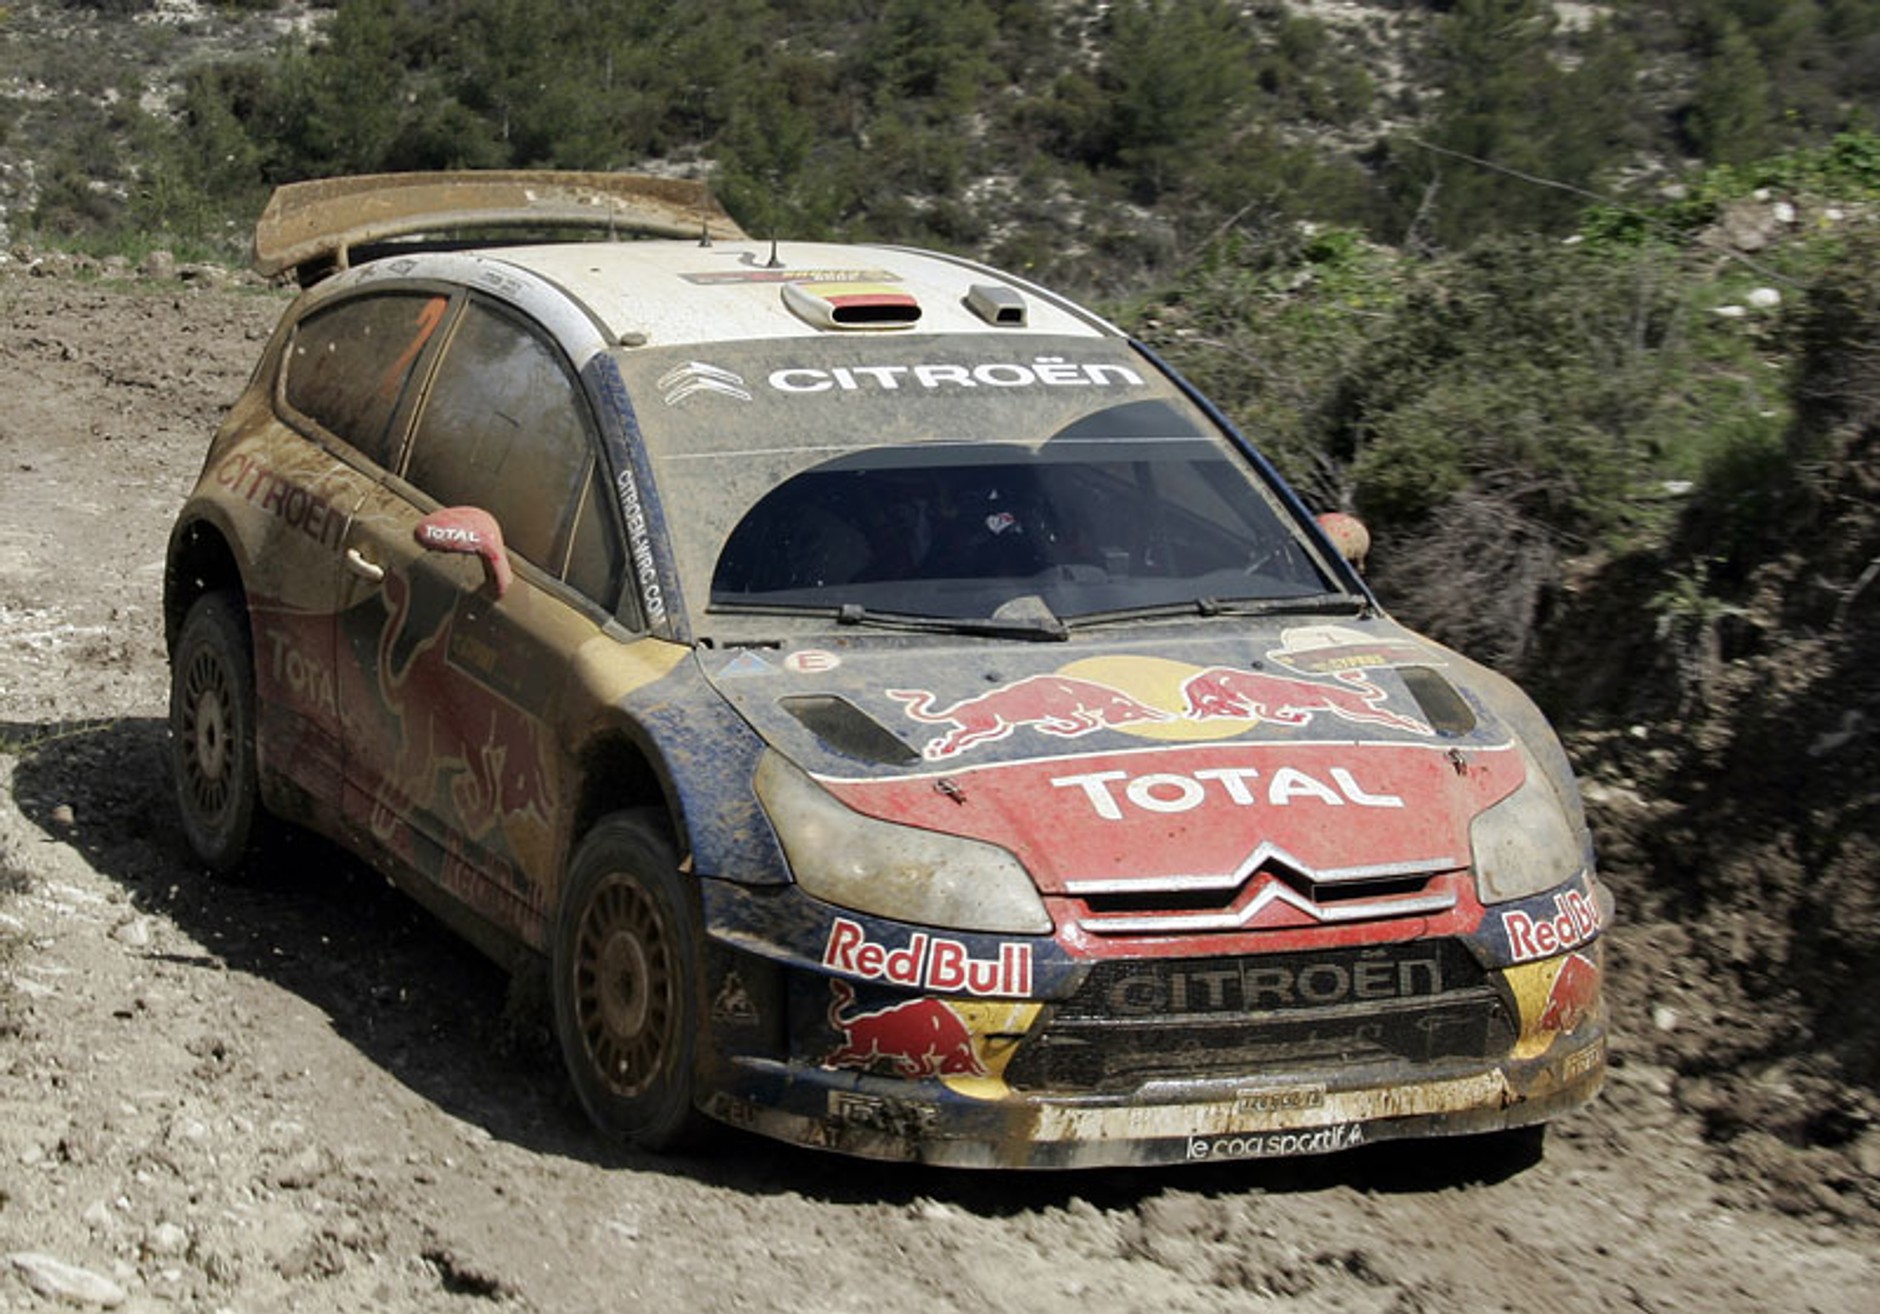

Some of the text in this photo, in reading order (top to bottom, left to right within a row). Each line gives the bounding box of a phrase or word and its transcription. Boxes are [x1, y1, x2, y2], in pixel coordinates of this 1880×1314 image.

[425, 525, 481, 543] TOTAL
[1050, 767, 1405, 820] TOTAL
[1503, 892, 1577, 961] Red
[824, 918, 1032, 997] Red Bull
[1186, 1136, 1209, 1160] le
